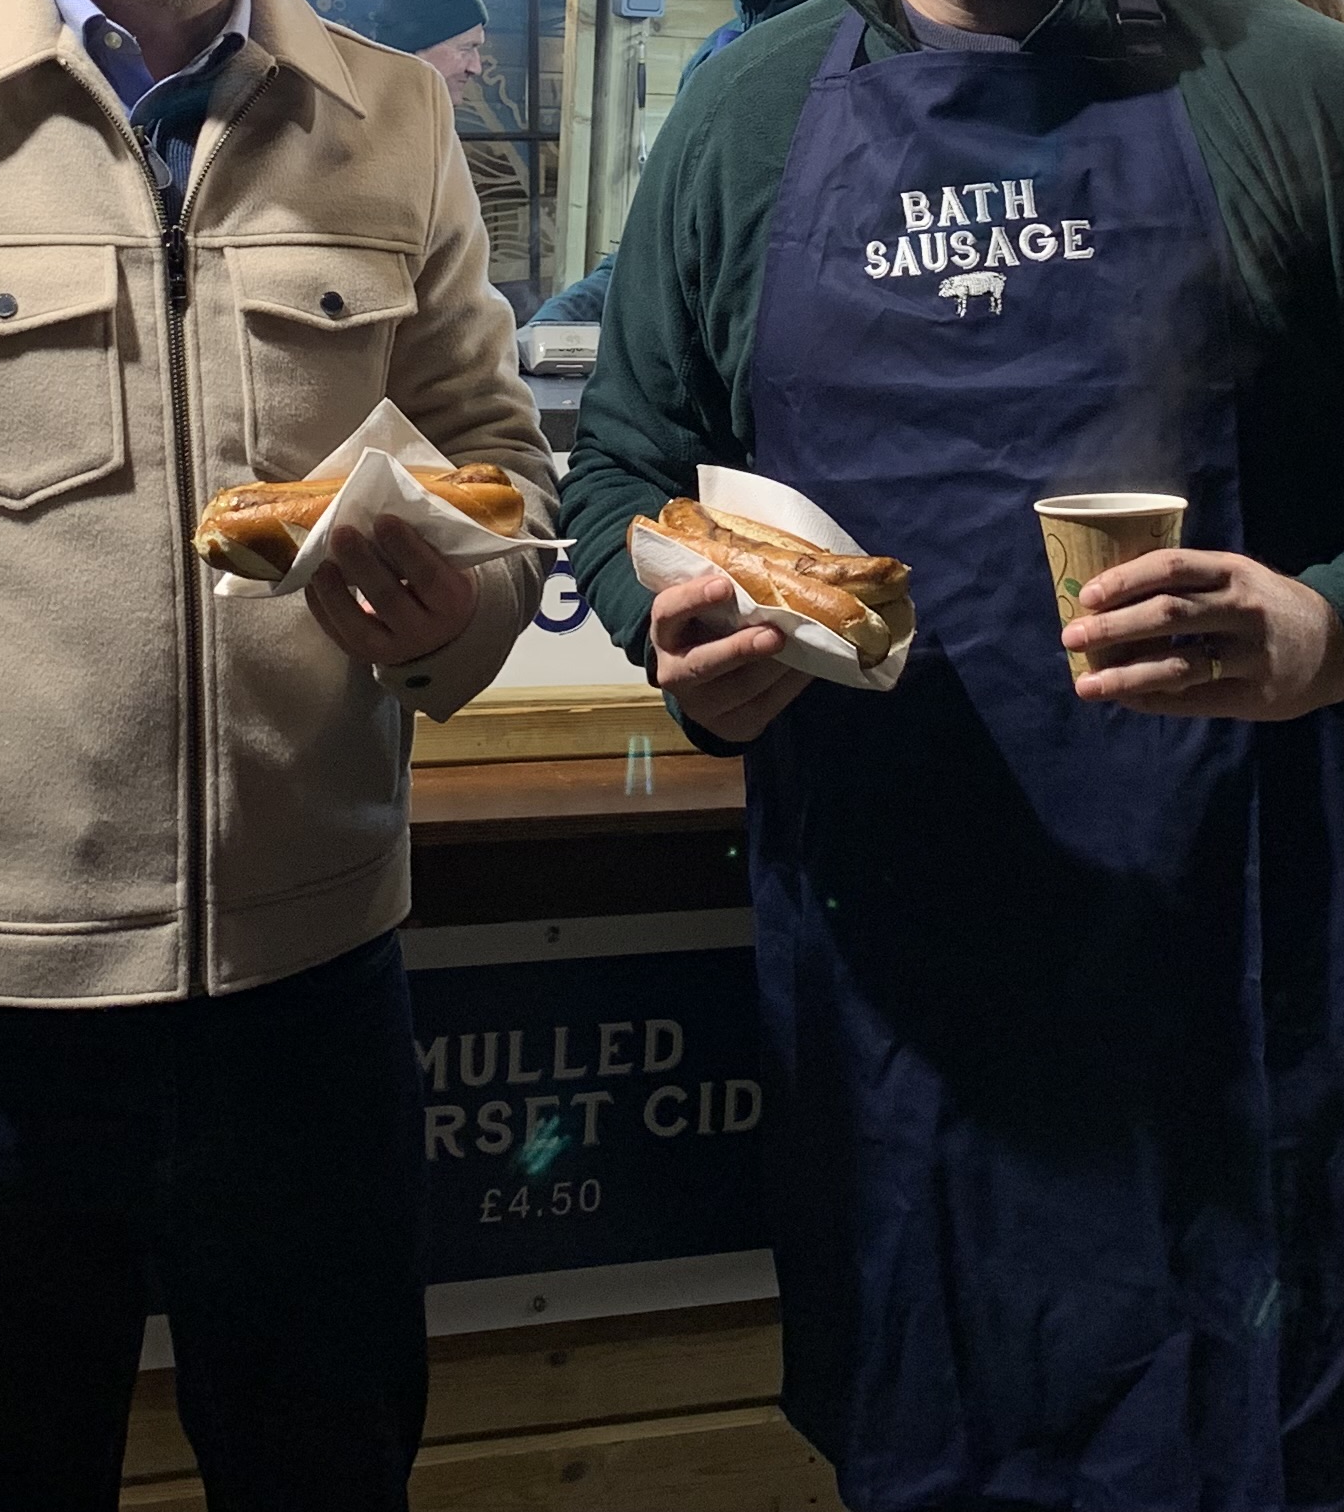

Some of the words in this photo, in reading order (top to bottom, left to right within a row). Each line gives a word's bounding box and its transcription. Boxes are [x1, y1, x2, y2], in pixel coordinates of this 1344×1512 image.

[900, 179, 1039, 234] BATH
[863, 219, 1095, 279] SAUSAGE
[413, 1019, 684, 1092] MULLED
[479, 1178, 602, 1223] £4.50
